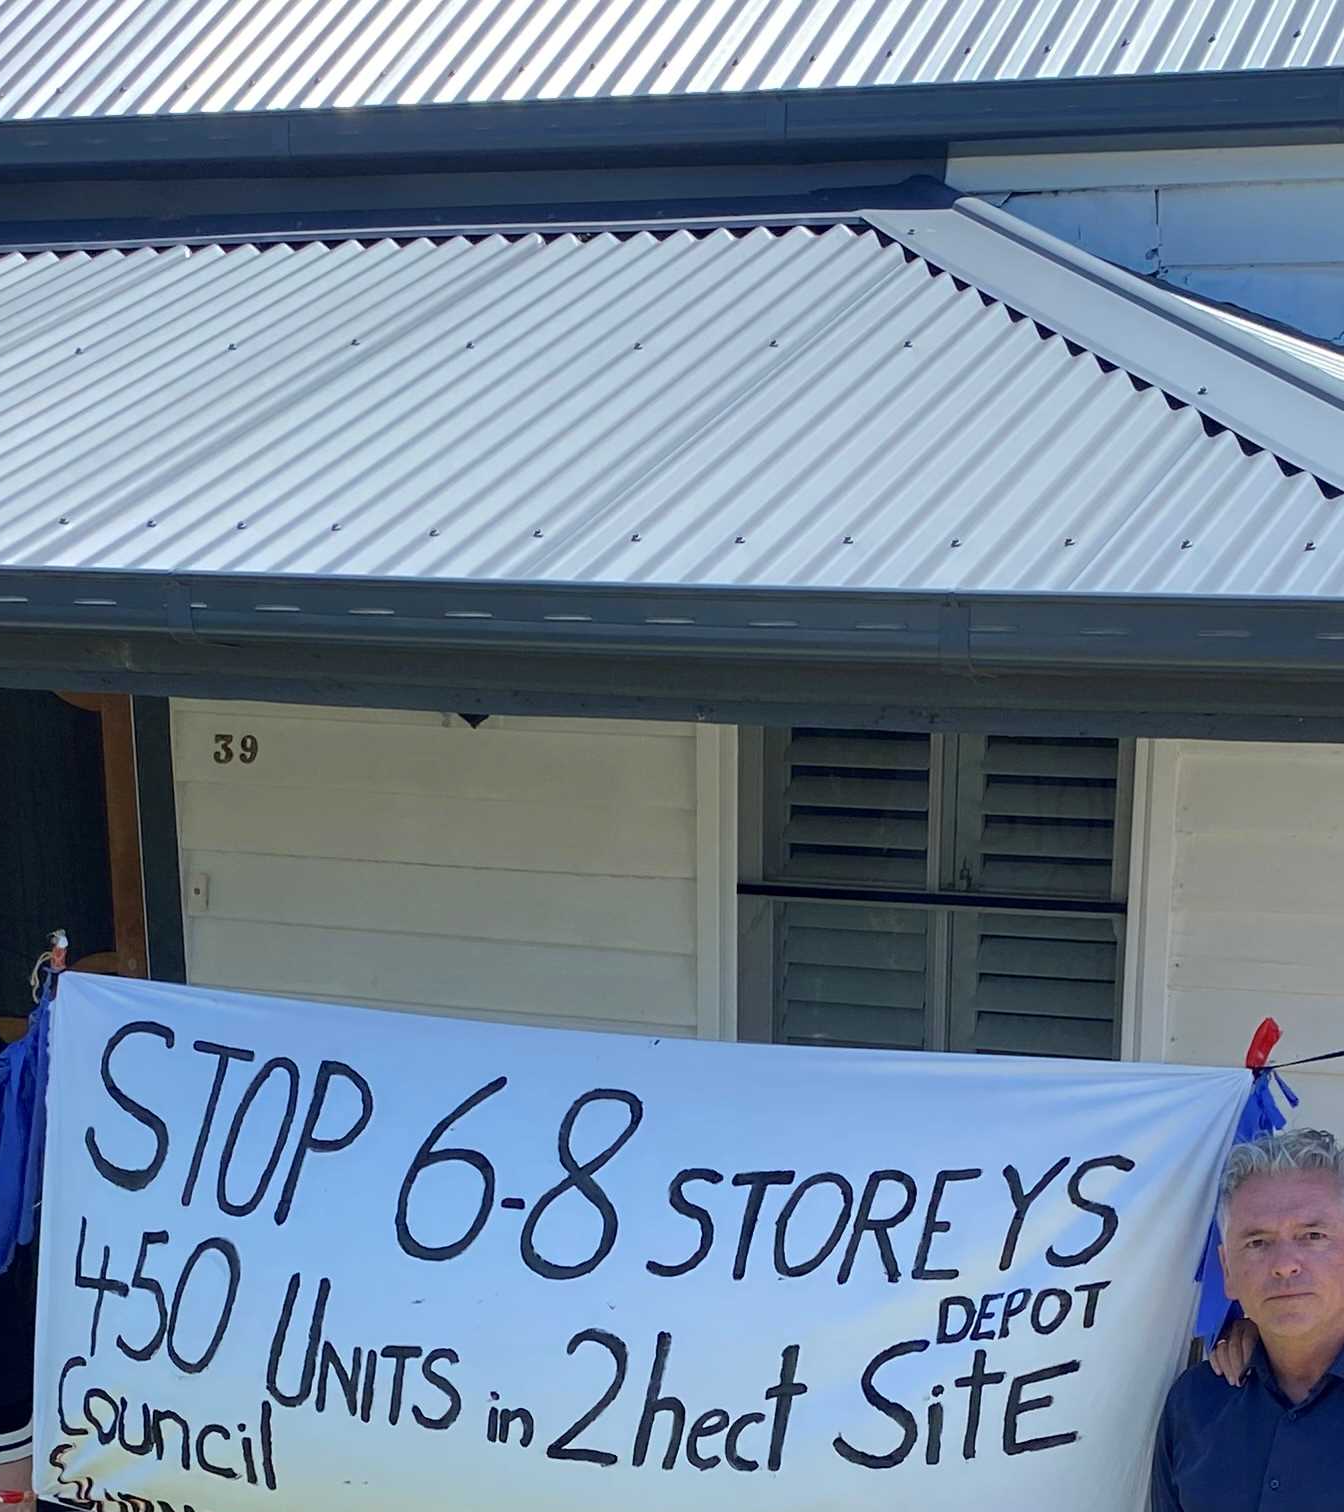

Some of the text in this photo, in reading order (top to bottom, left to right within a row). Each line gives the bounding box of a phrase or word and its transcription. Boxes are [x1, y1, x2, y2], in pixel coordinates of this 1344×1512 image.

[214, 733, 258, 764] 39
[85, 1021, 1135, 1284] STOP 6-8 STOREYS
[74, 1216, 241, 1374] 450
[267, 1272, 462, 1429] UNITS
[486, 1391, 534, 1447] in
[937, 1280, 1111, 1344] DEPOT
[58, 1356, 277, 1490] Council
